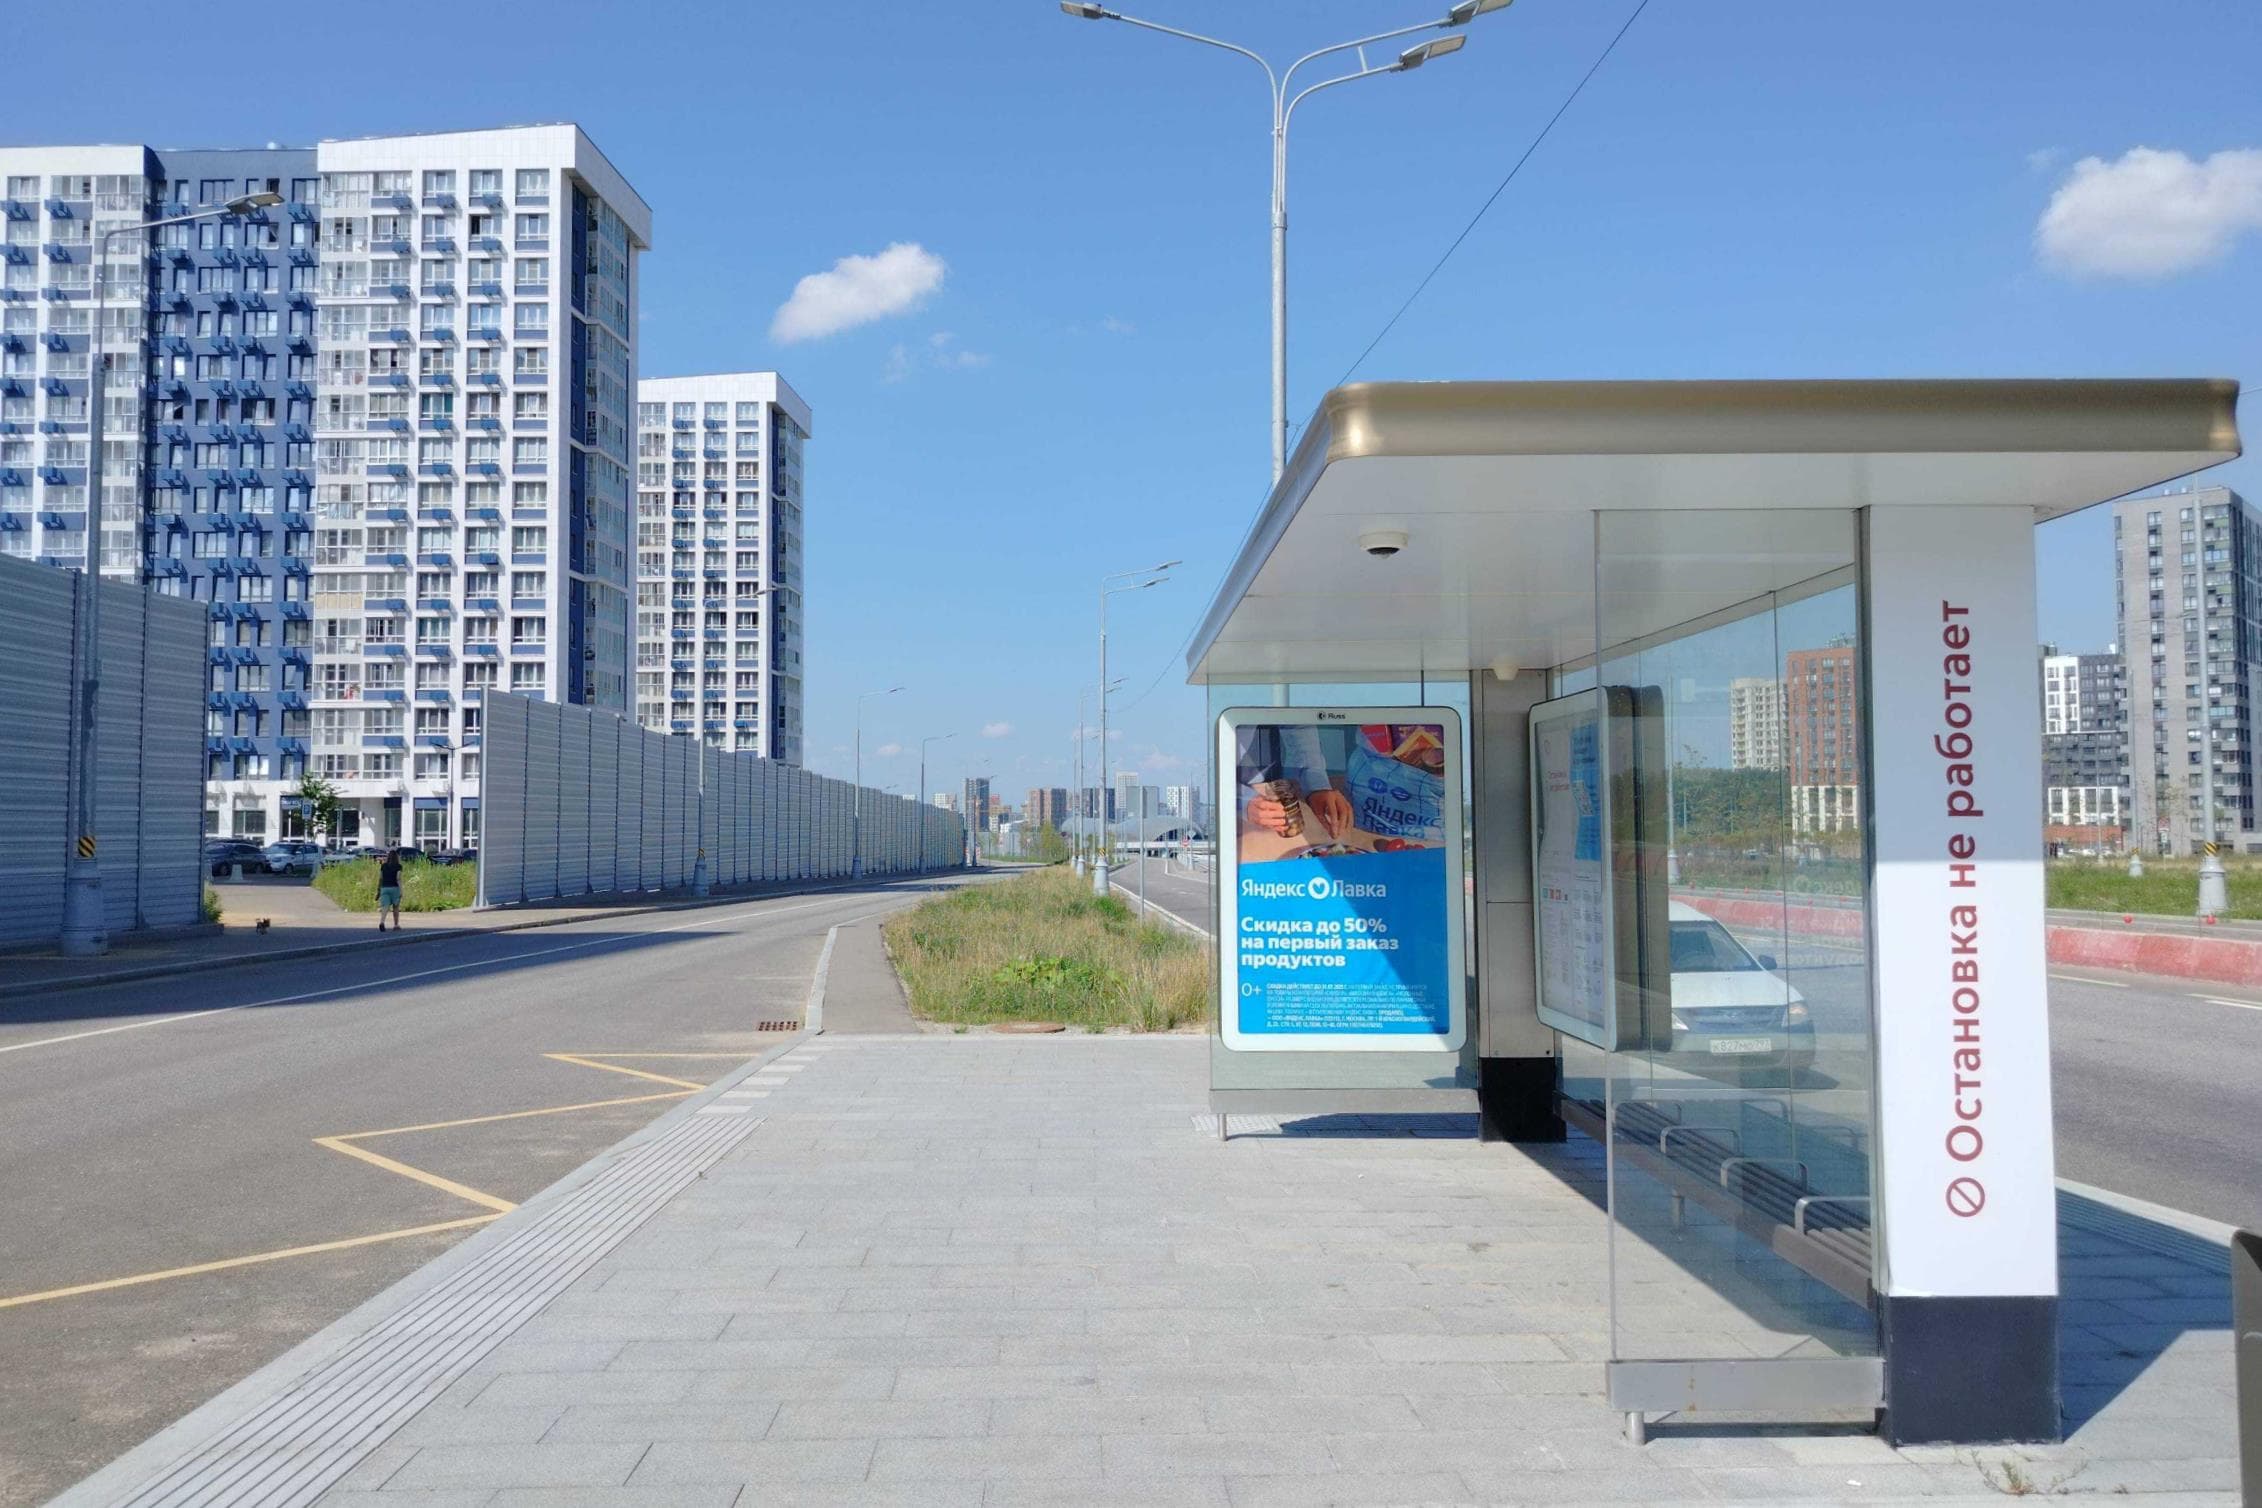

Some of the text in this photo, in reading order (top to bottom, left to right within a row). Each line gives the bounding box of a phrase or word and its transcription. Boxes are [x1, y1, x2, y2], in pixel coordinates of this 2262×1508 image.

[1362, 797, 1441, 828] Яндекс
[1242, 879, 1386, 898] Яндекс Лавка
[1934, 600, 1984, 1162] Остановка не работает
[1241, 917, 1387, 935] Скидка до 50%
[1241, 935, 1399, 952] на первый заказ
[1241, 954, 1346, 969] продуктов
[1241, 982, 1262, 997] 0+
